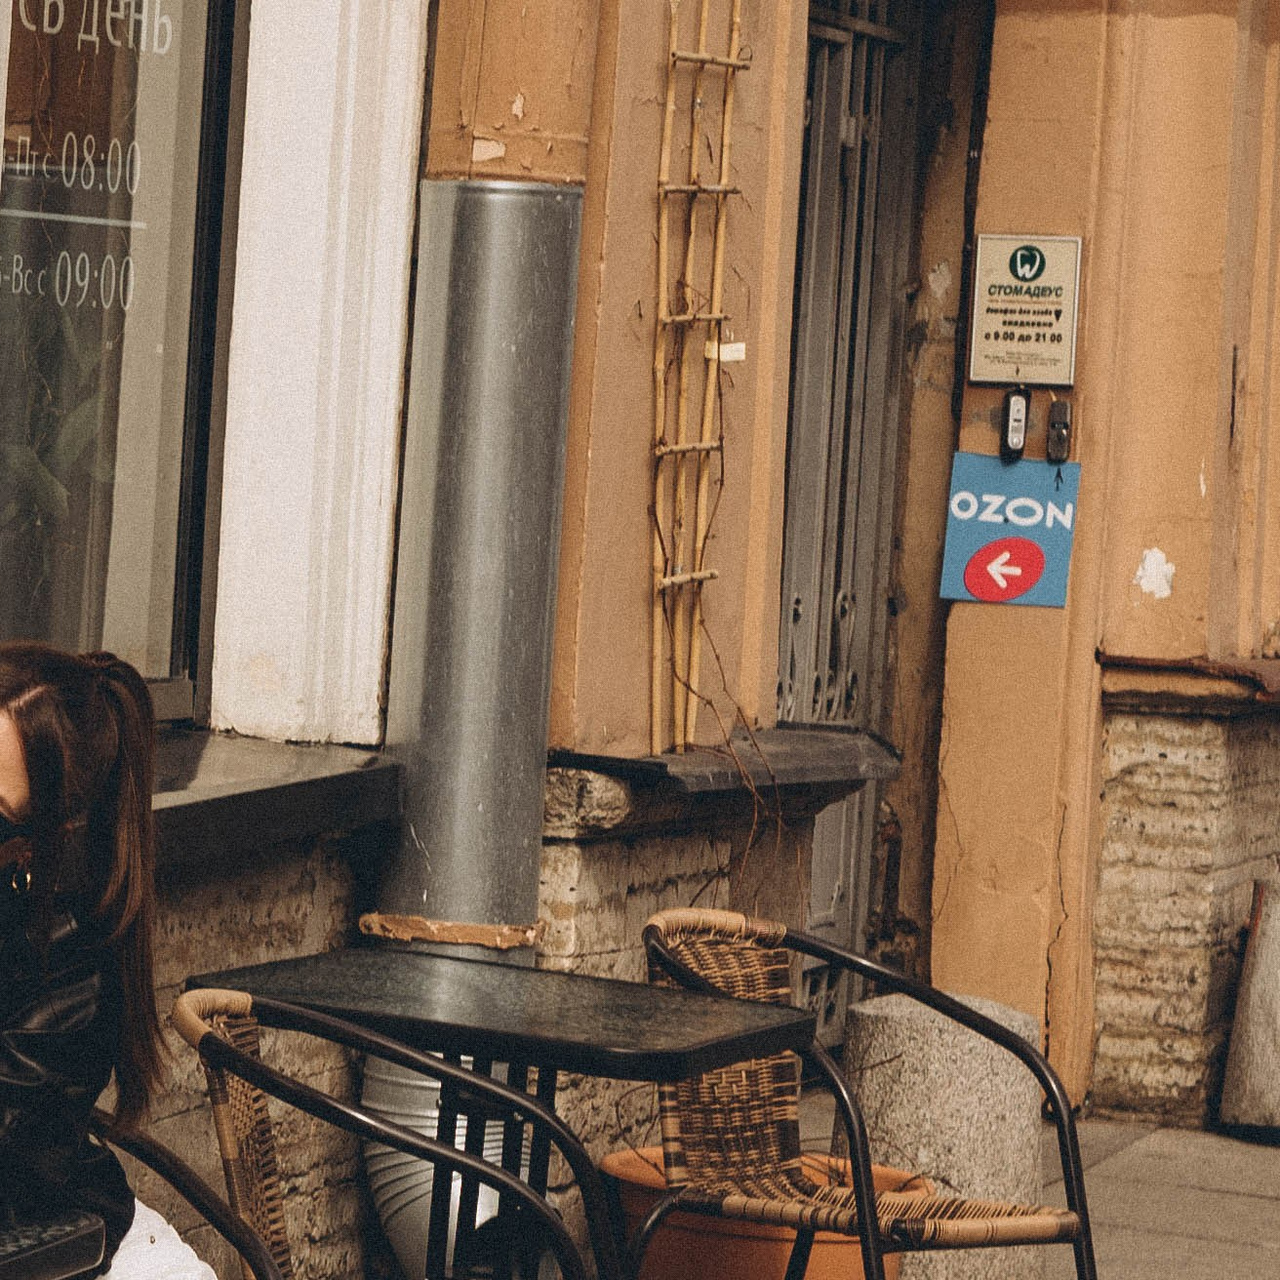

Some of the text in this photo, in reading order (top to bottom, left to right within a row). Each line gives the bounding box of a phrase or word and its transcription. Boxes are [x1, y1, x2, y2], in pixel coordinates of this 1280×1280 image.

[61, 131, 141, 196] 08:00
[55, 251, 135, 310] 09:00
[988, 284, 1063, 298] СТОМАДЕУС
[1018, 334, 1032, 342] до
[951, 491, 1073, 530] OZON
